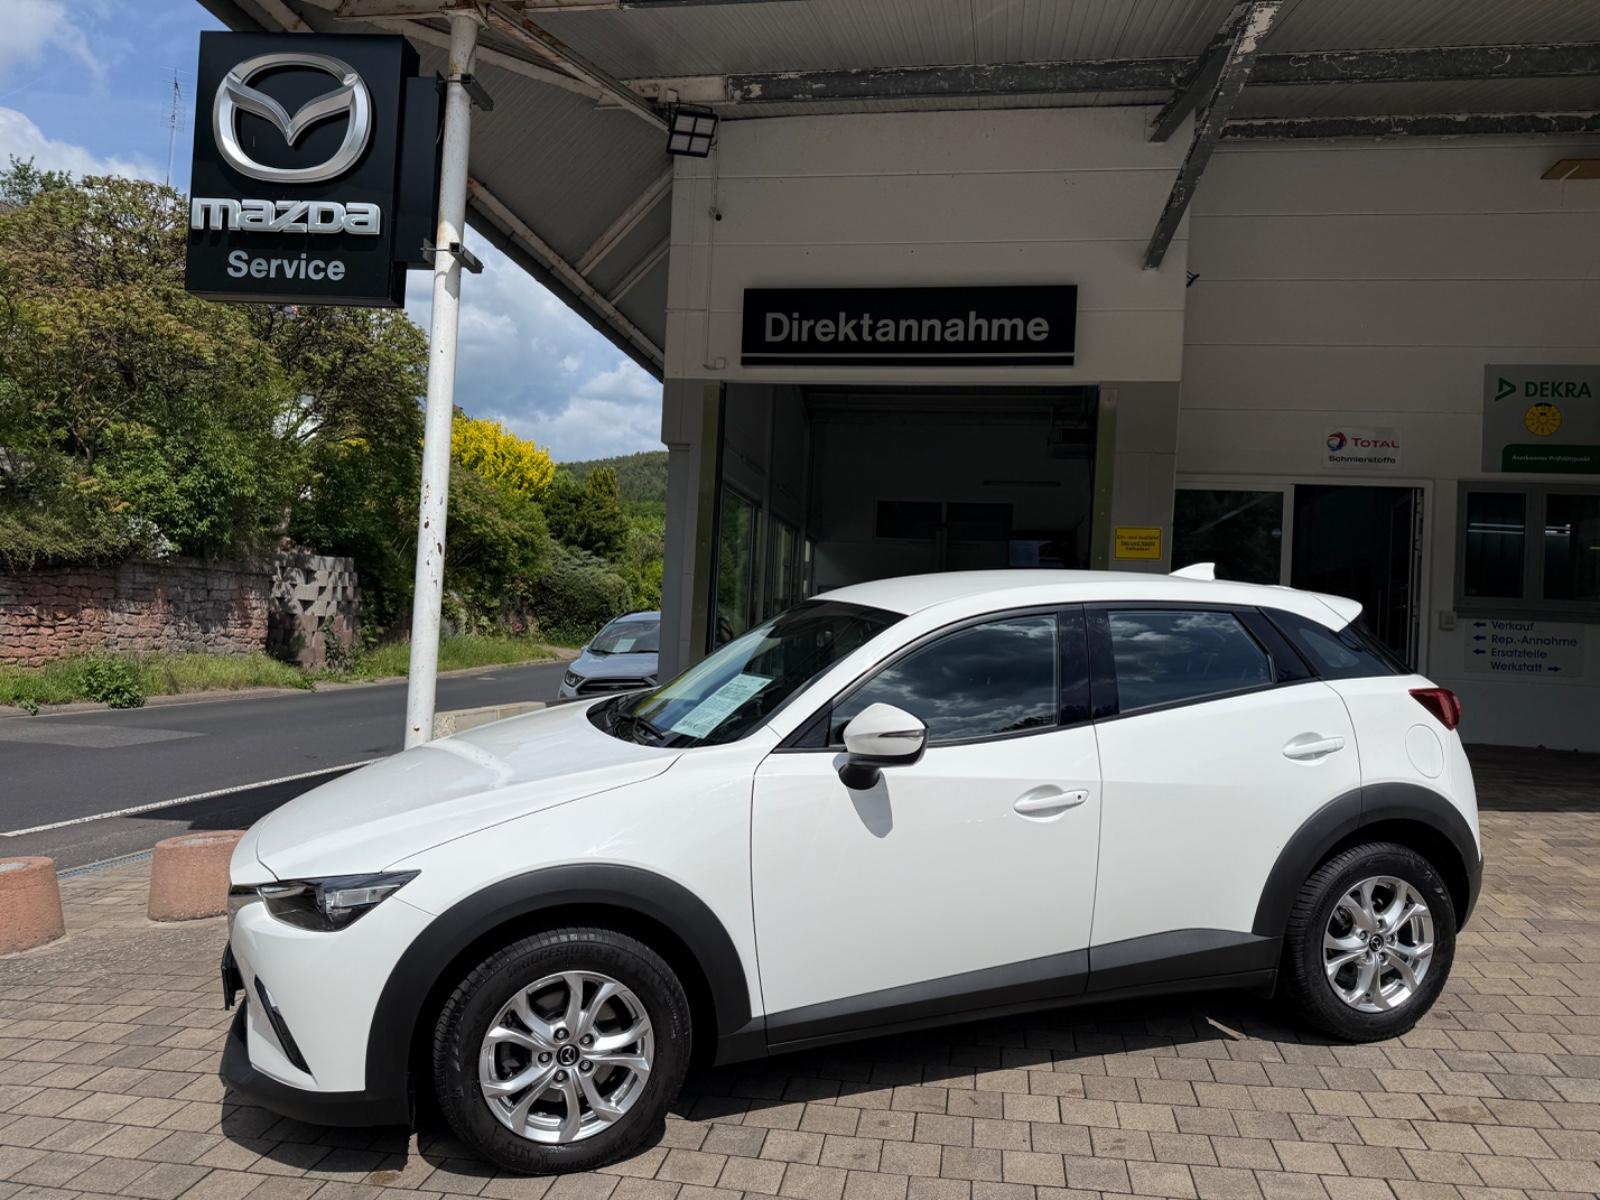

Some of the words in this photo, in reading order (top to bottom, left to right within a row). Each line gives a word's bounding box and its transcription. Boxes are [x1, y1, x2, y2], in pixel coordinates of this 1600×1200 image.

[191, 197, 380, 235] mazda
[227, 249, 346, 281] Service
[764, 310, 1051, 343] Direktannahme
[1524, 381, 1592, 399] DEKRA
[1350, 437, 1400, 449] TOTAL
[1328, 455, 1396, 464] Schmierstoffe
[1491, 620, 1535, 632] Verkauf
[1490, 647, 1548, 659] Ersatzteile
[1490, 661, 1542, 673] Werkstatt
